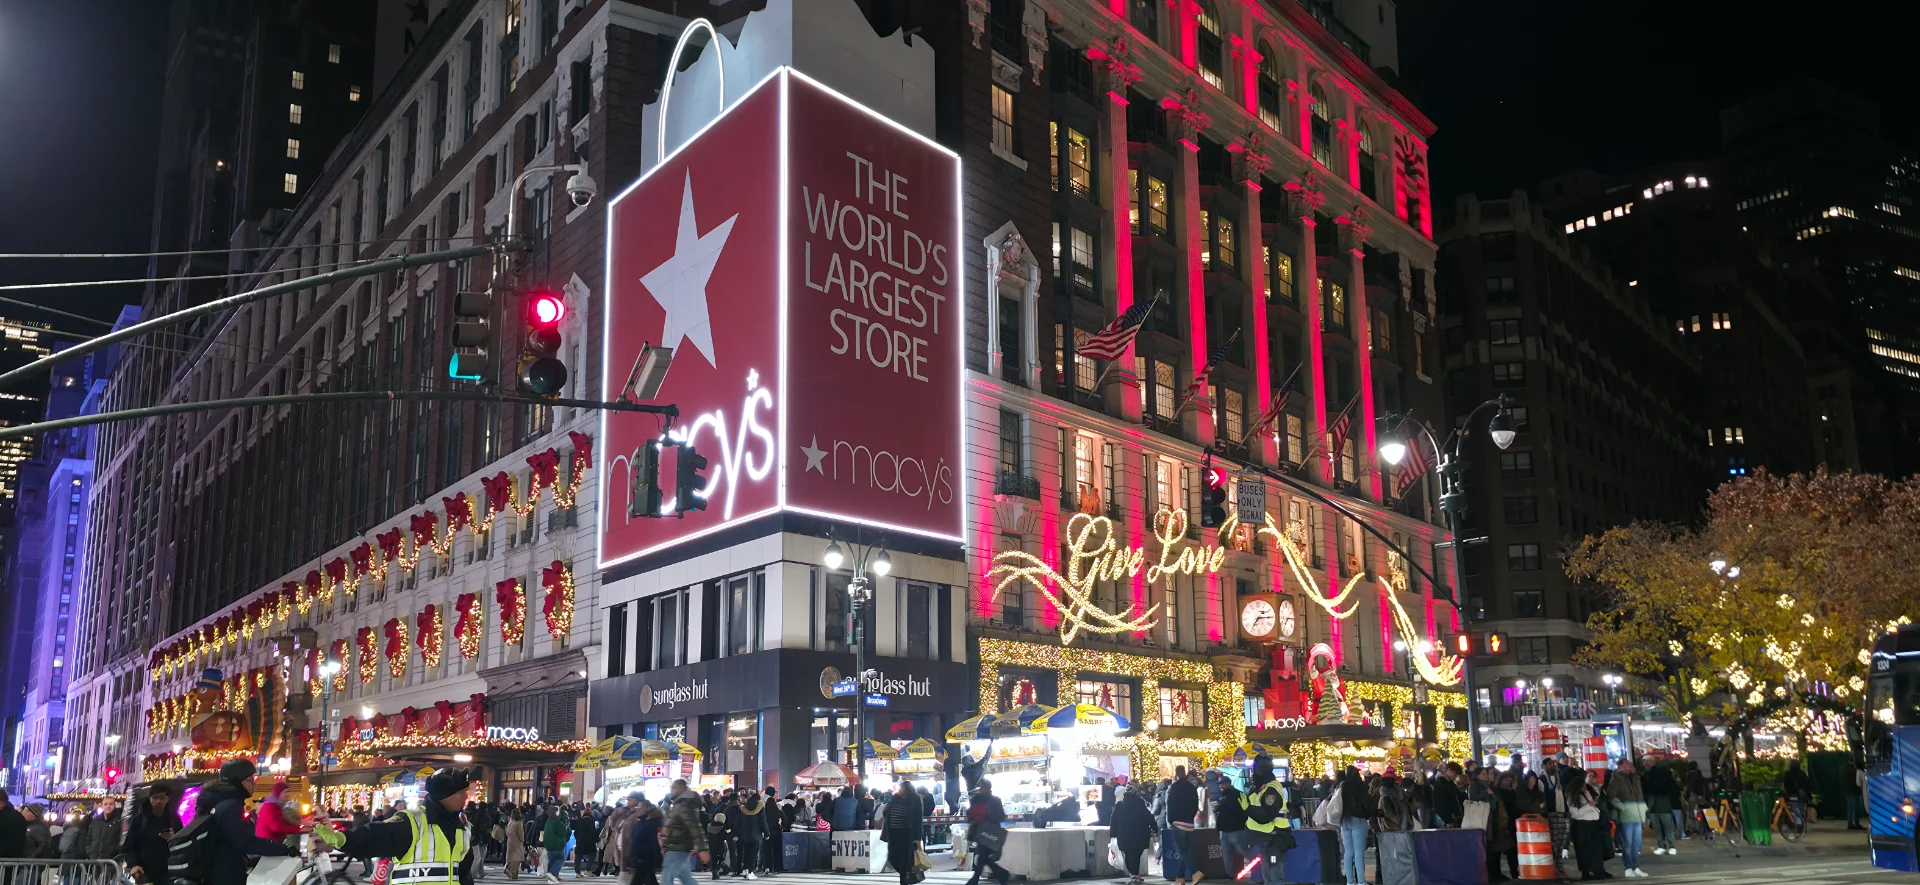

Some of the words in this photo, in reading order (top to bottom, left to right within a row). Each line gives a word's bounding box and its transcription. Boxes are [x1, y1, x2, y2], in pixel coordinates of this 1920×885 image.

[846, 150, 909, 220] THE
[802, 184, 948, 286] WORLD'S
[805, 241, 945, 334] LARGEST
[829, 308, 928, 382] STORE
[833, 439, 953, 510] macy's
[1239, 484, 1264, 496] BUSES
[1241, 497, 1262, 508] ONLY
[1239, 510, 1263, 520] SIGNAL
[1067, 513, 1145, 587] Give
[1148, 508, 1225, 584] Love
[653, 681, 691, 709] sunglass
[692, 678, 709, 699] hut
[845, 671, 906, 696] nglass
[908, 674, 931, 697] hut
[1480, 707, 1503, 724] BAN
[644, 765, 666, 777] OPEN
[836, 839, 865, 857] NYPD
[408, 867, 431, 877] NY
